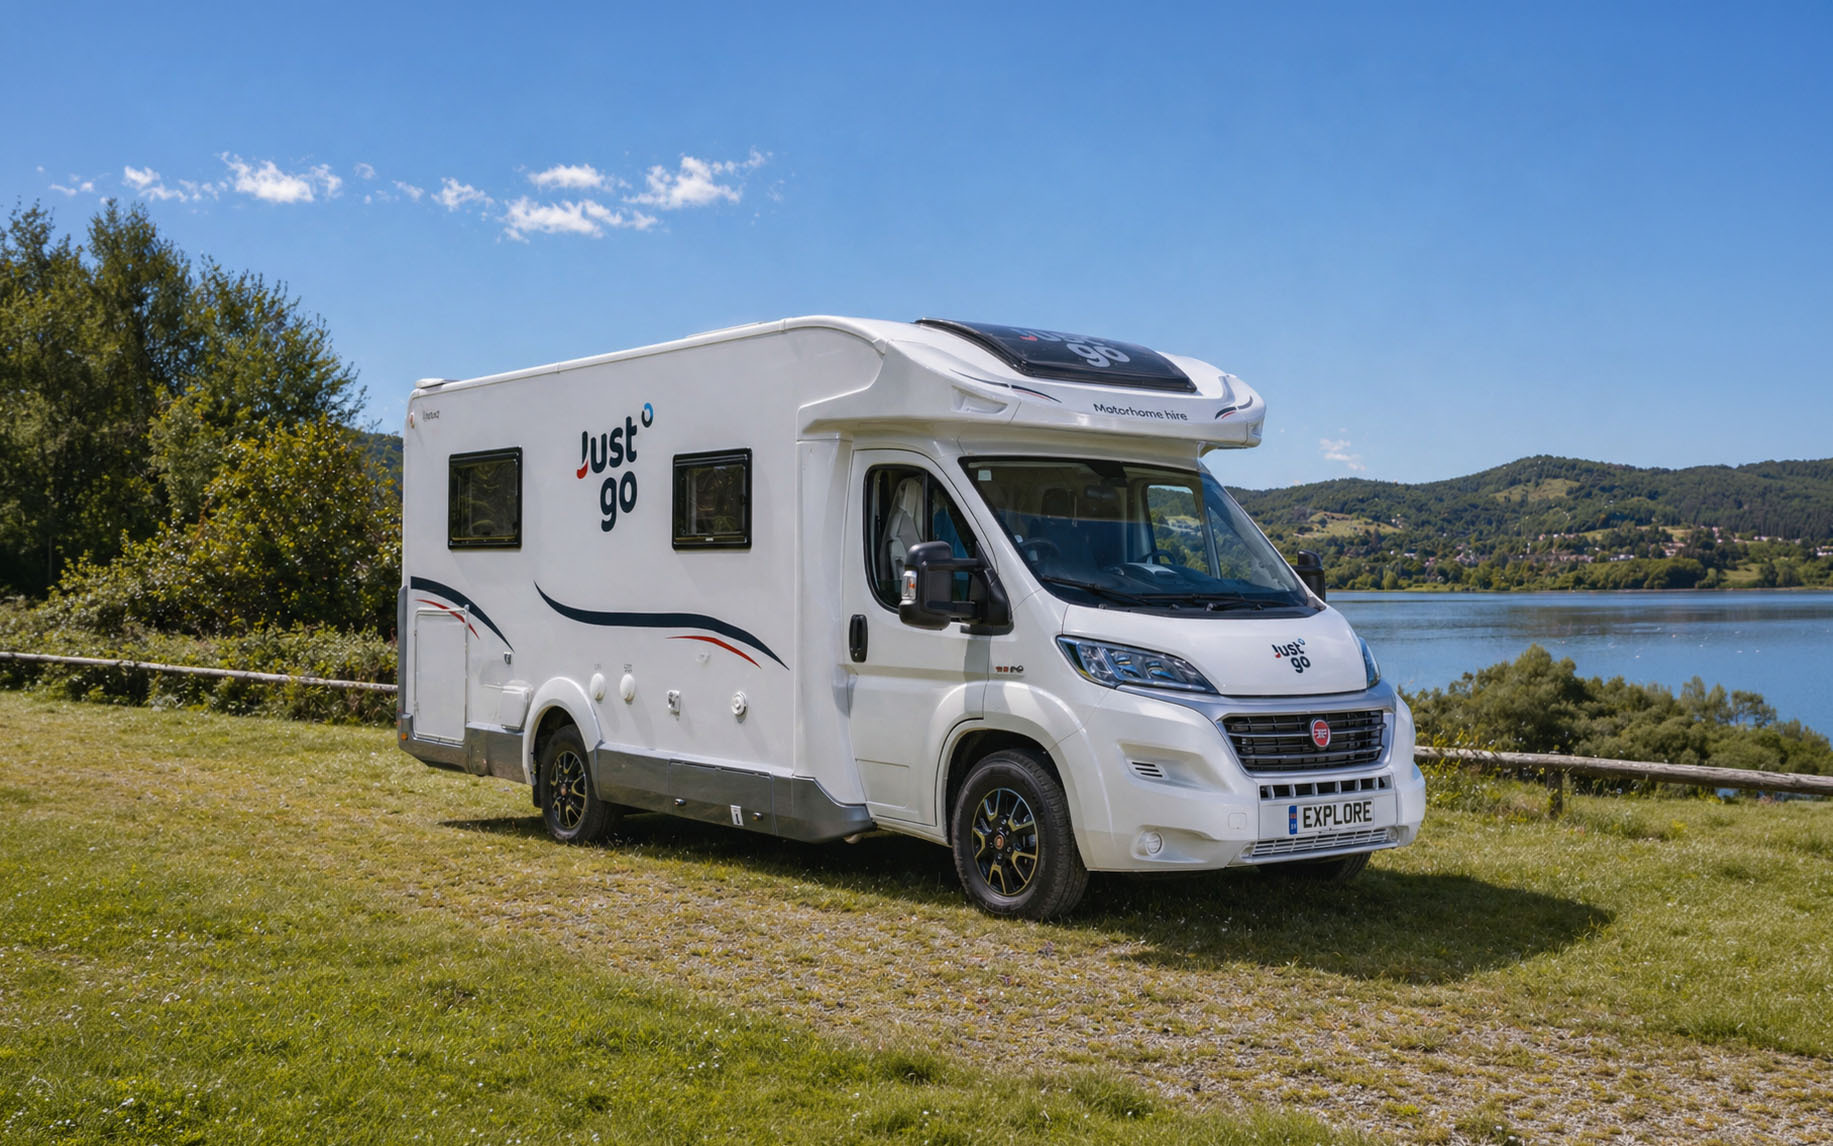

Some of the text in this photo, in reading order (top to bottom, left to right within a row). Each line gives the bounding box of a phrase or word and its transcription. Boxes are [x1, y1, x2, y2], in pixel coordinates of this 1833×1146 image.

[1066, 342, 1131, 368] go
[1164, 409, 1188, 421] hire
[576, 415, 638, 480] Just
[600, 471, 638, 532] go
[1271, 641, 1305, 659] Just
[1290, 655, 1311, 674] go
[1303, 801, 1373, 828] EXPLORE
